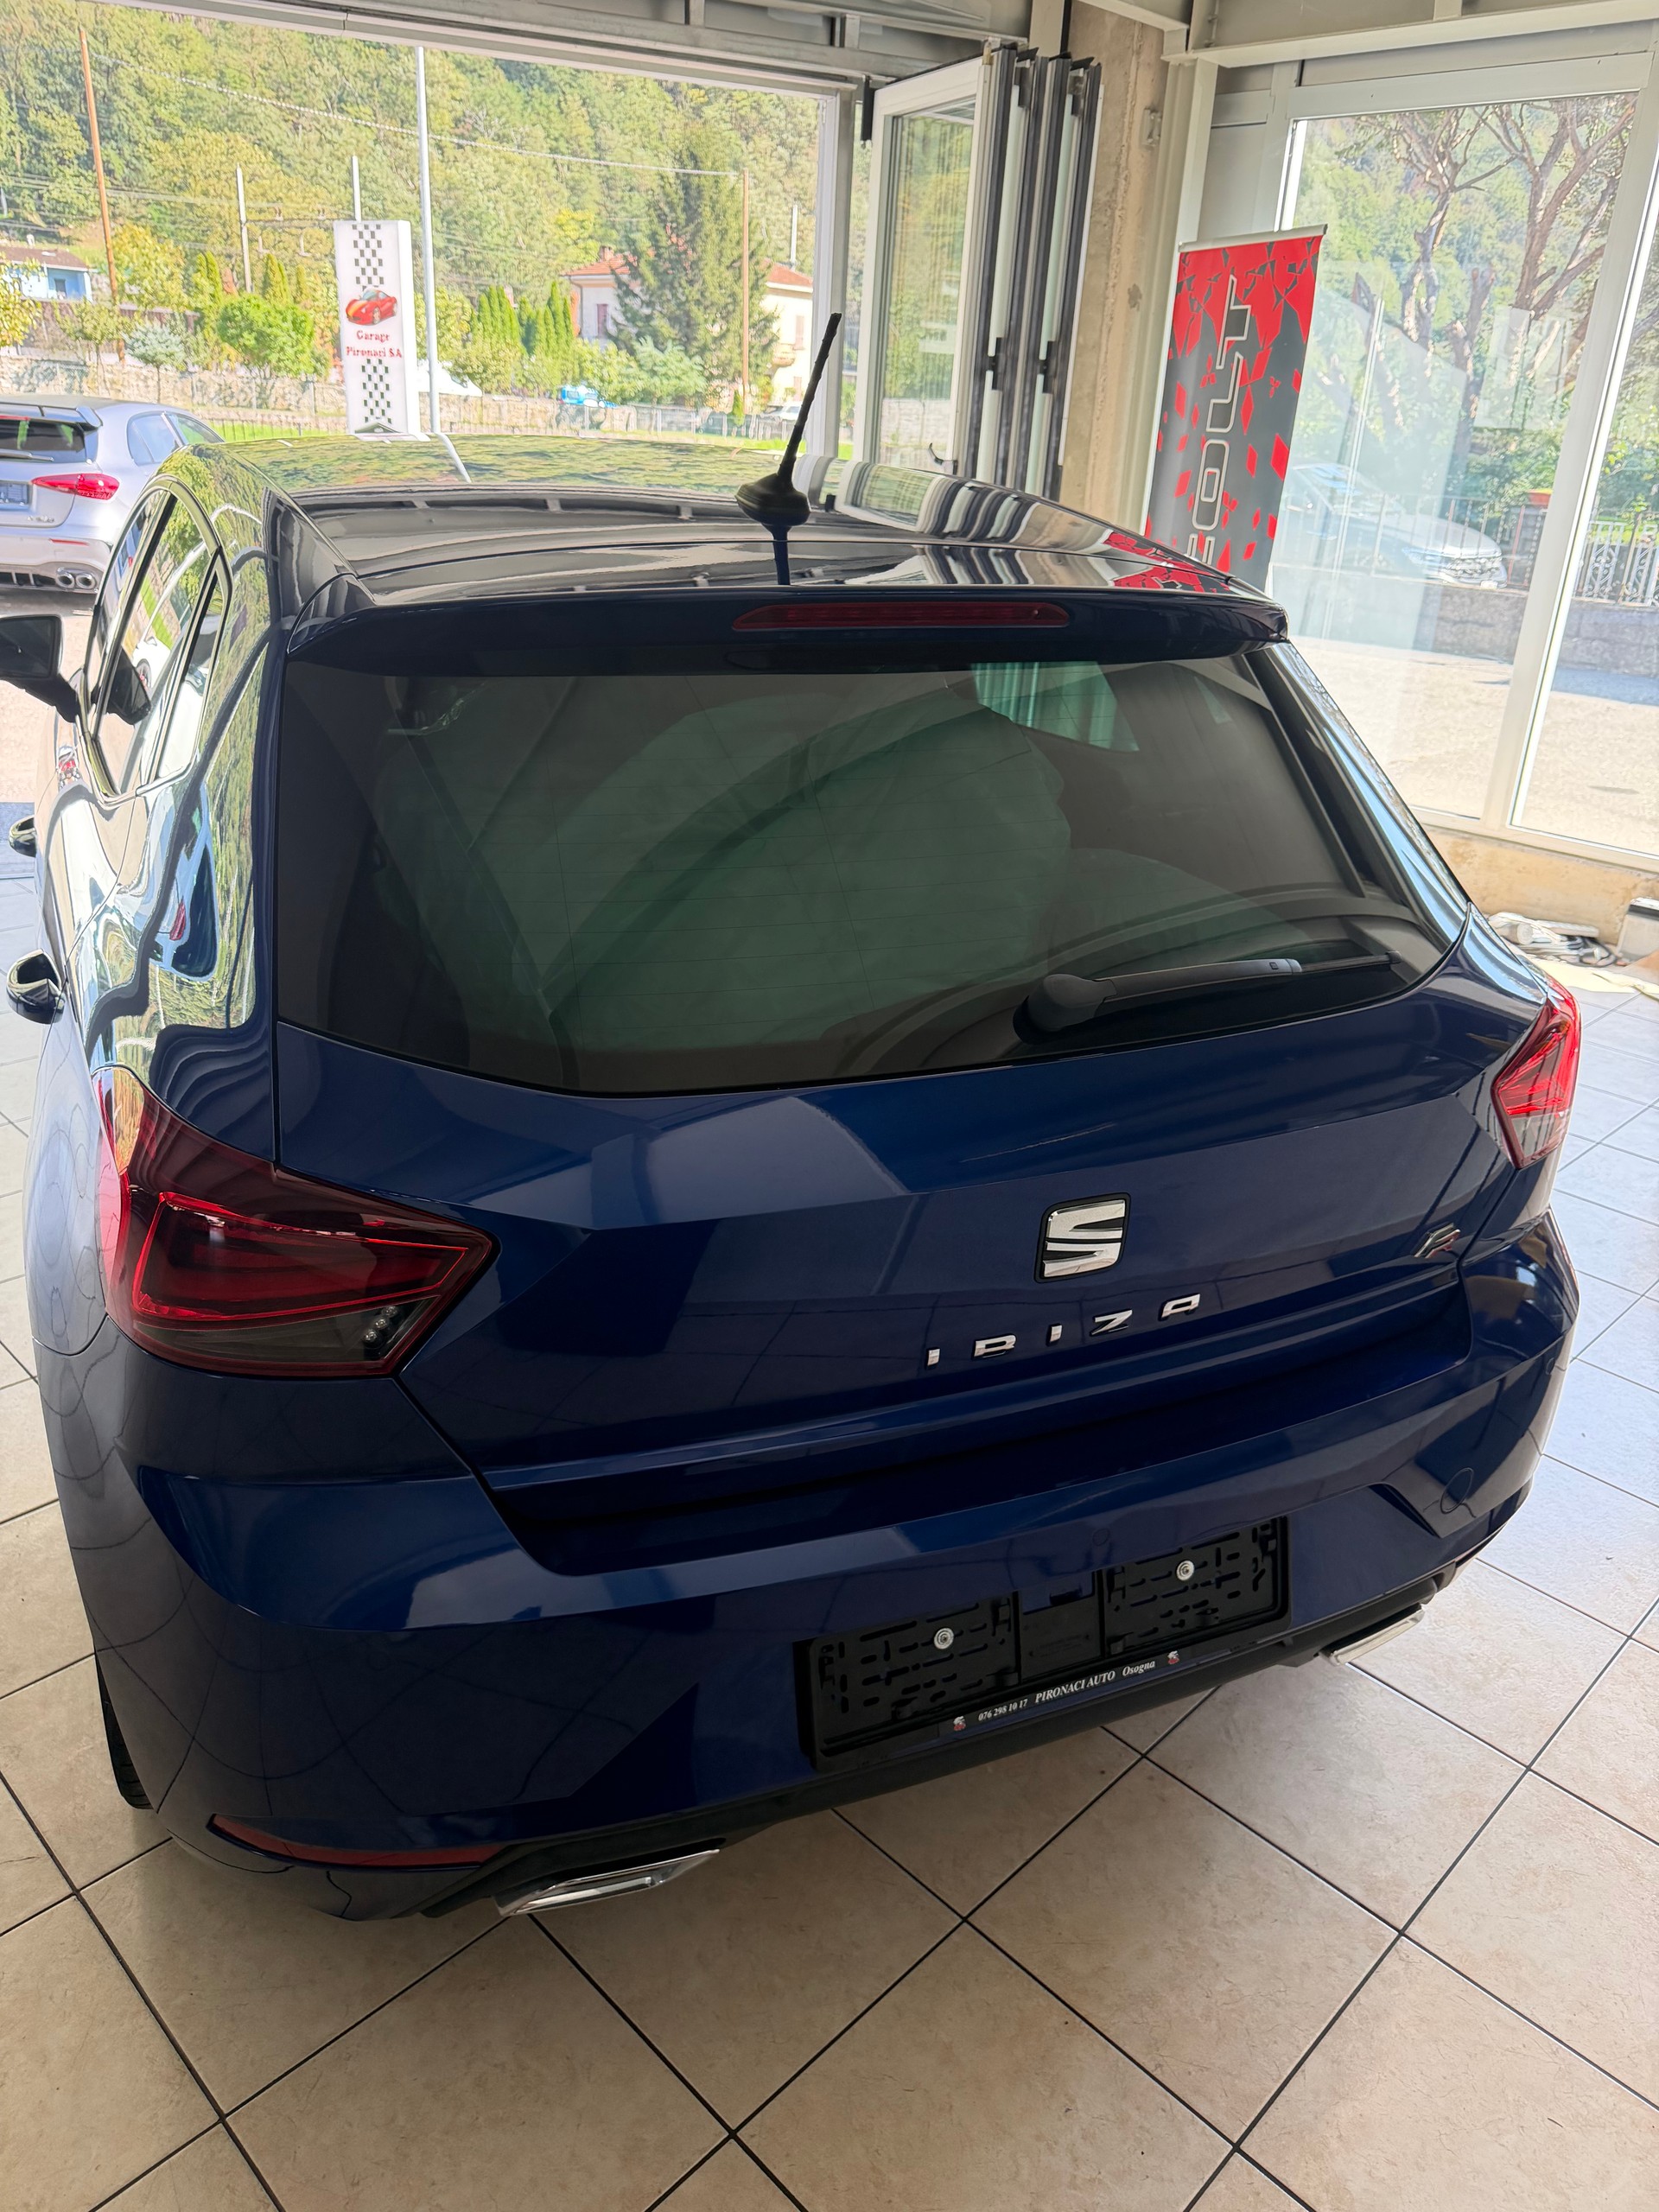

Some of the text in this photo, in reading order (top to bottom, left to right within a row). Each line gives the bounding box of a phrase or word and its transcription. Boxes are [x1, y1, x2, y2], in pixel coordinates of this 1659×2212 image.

[356, 330, 390, 343] Garage
[389, 348, 403, 358] SA
[926, 1293, 1201, 1368] IBIZA
[977, 1710, 993, 1721] 076
[1007, 1701, 1018, 1712] 10
[1019, 1698, 1028, 1709] 17
[1034, 1680, 1086, 1704] PIRONACI
[1085, 1670, 1116, 1688] AUTO
[1122, 1660, 1156, 1676] Osogna
